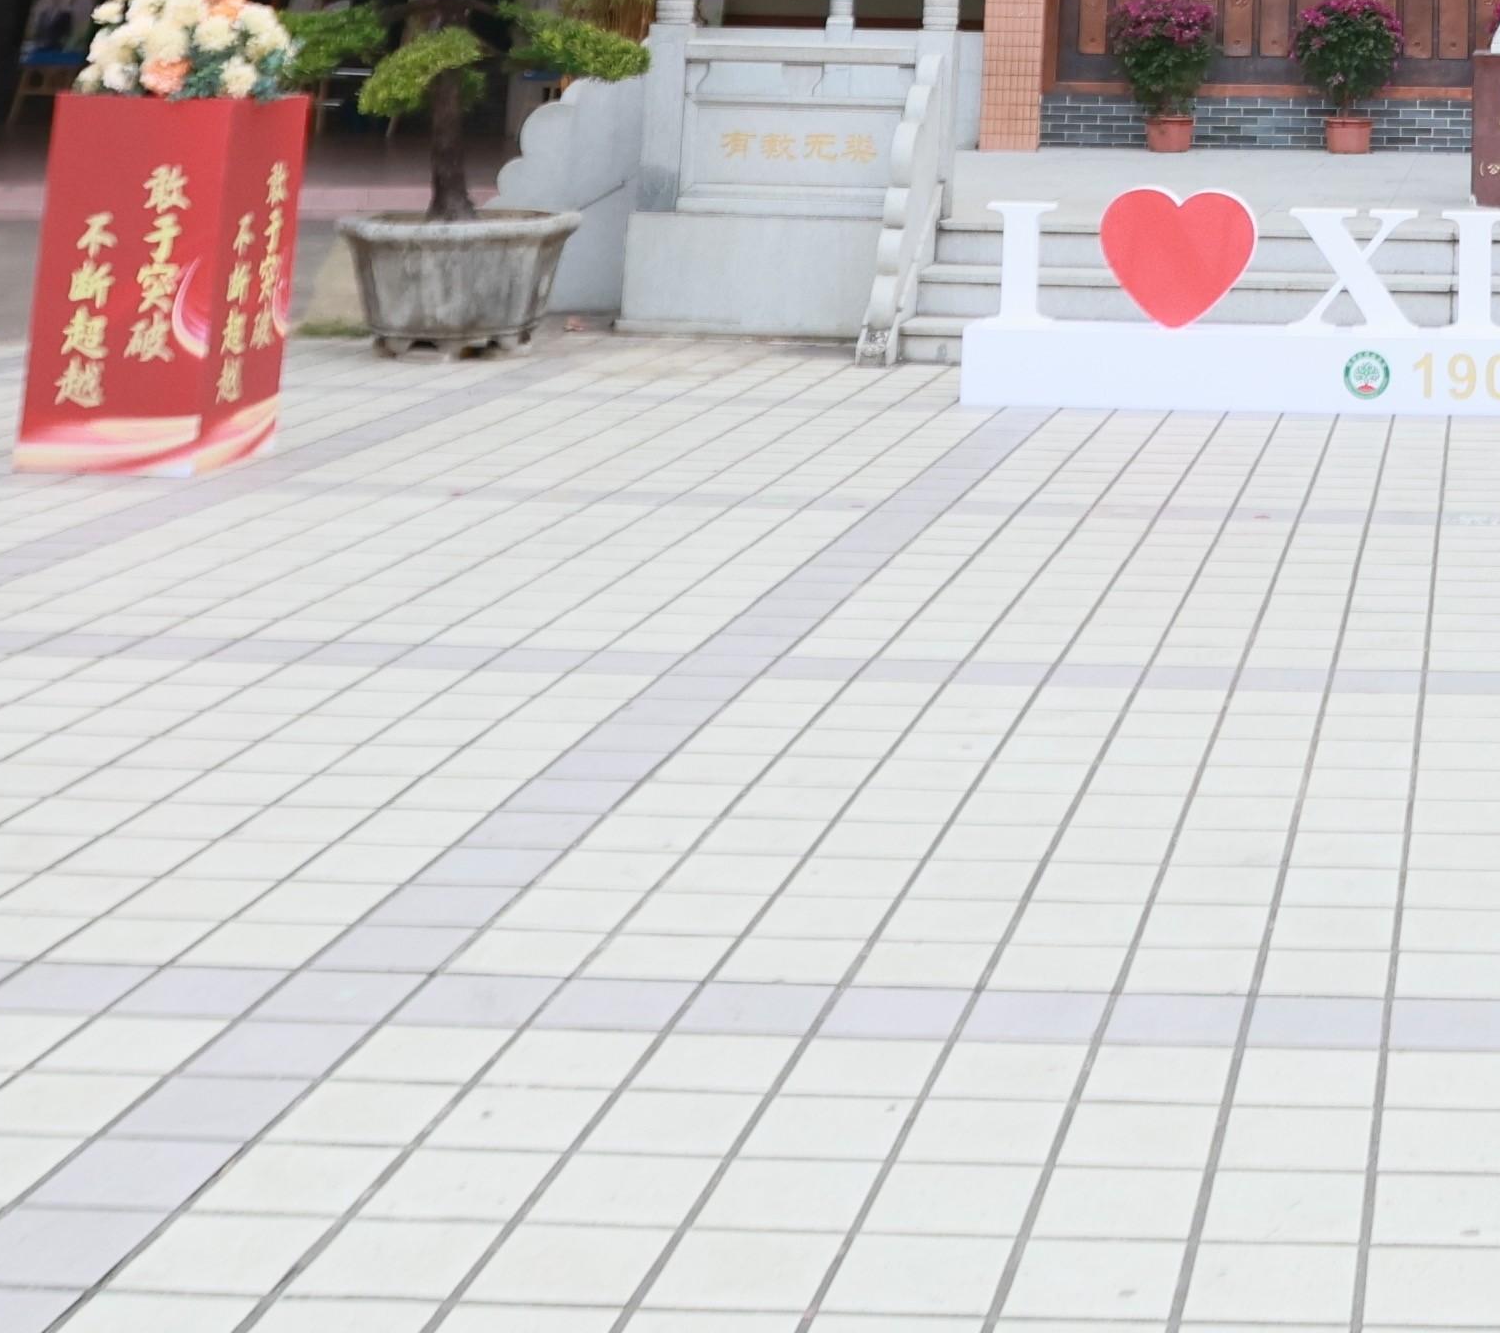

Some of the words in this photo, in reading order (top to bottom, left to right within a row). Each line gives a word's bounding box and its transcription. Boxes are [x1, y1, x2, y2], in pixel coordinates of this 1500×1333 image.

[53, 210, 118, 409] 不断超越
[122, 163, 192, 364] 敢于突破
[215, 210, 255, 405] 不断超越
[988, 200, 1058, 323] I
